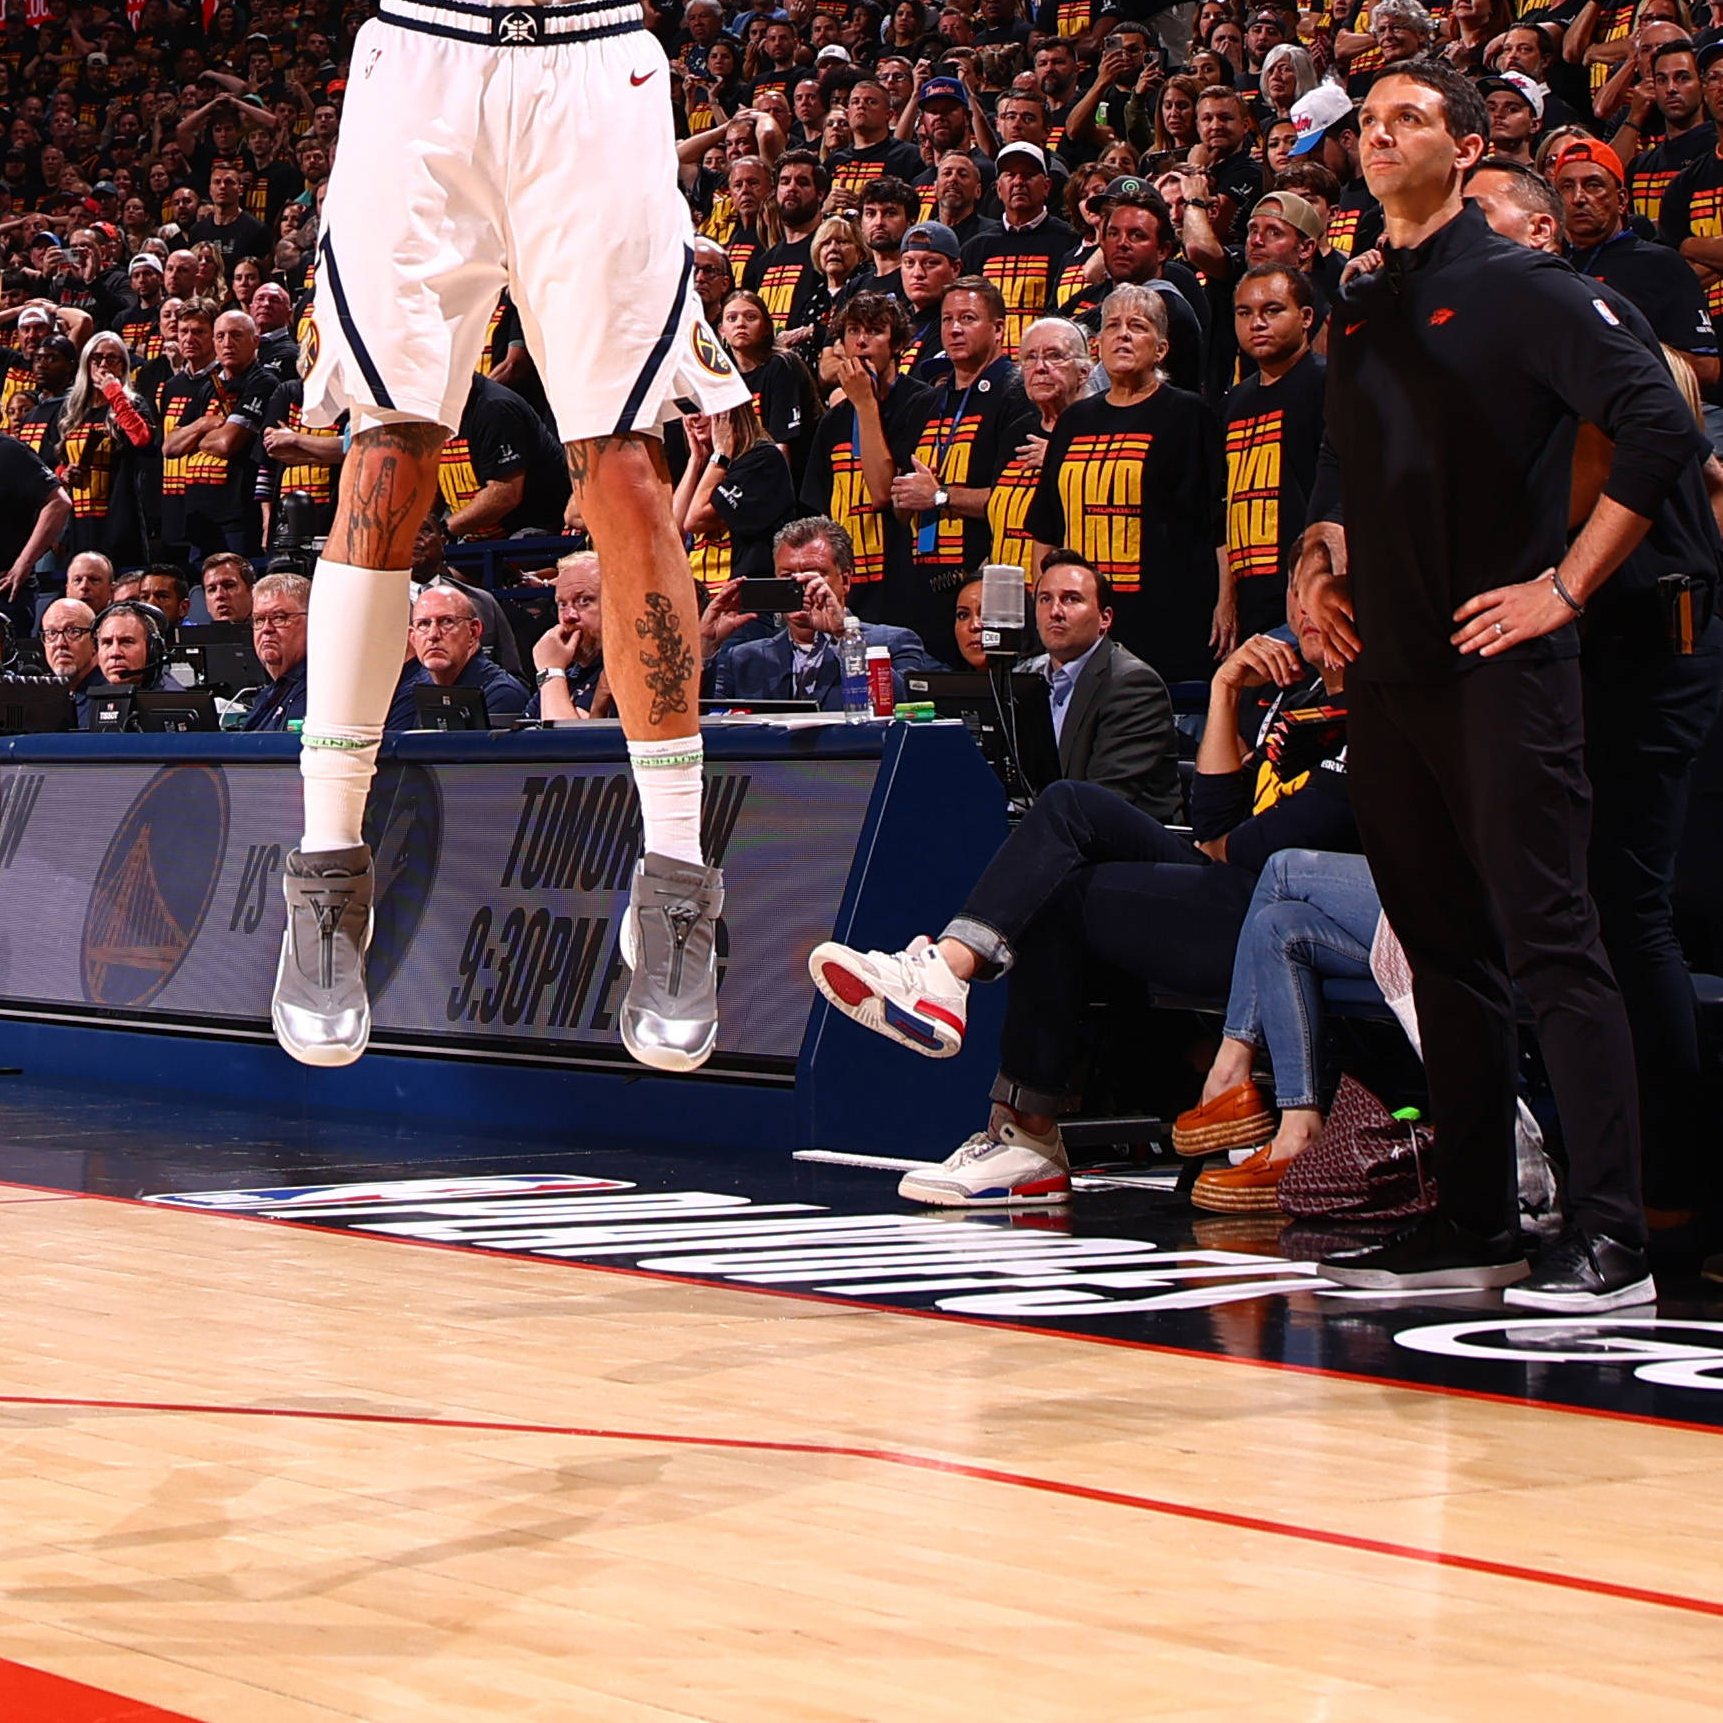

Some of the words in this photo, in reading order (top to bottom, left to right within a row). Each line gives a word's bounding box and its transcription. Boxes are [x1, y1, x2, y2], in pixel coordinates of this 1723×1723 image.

[1085, 505, 1141, 515] THUNDER
[500, 774, 752, 891] TOMORW
[229, 843, 282, 935] VS
[446, 905, 610, 1030] 9:30PM
